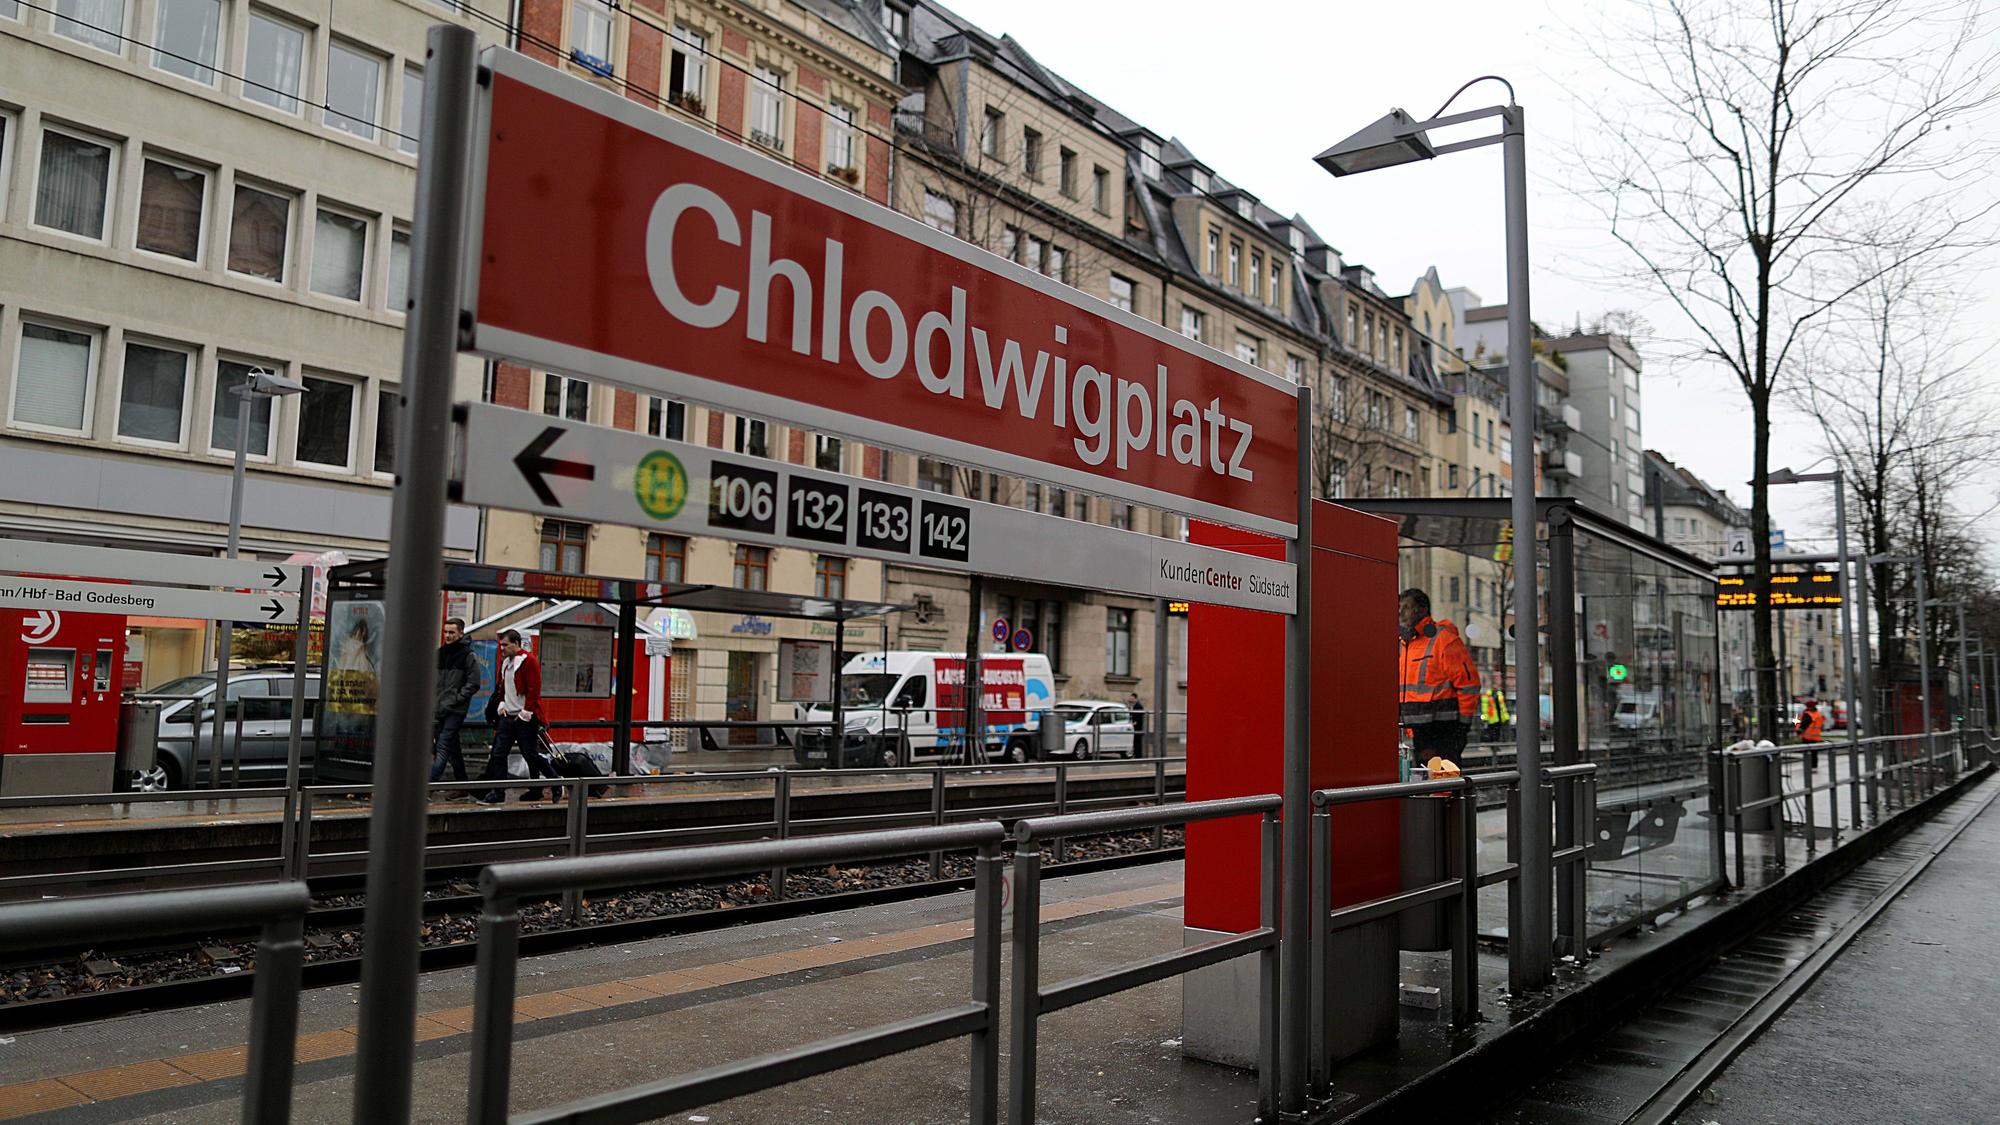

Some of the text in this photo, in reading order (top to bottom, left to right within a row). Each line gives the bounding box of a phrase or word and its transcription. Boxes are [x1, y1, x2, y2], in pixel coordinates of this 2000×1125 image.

[645, 183, 1254, 483] Chlodwigplatz
[712, 474, 773, 522] 106
[791, 489, 844, 533] 132
[859, 500, 909, 542] 133
[923, 512, 967, 551] 142
[1732, 540, 1746, 556] 4
[1160, 558, 1290, 598] KundenCenter Südstadt
[86, 592, 155, 609] Godesberg
